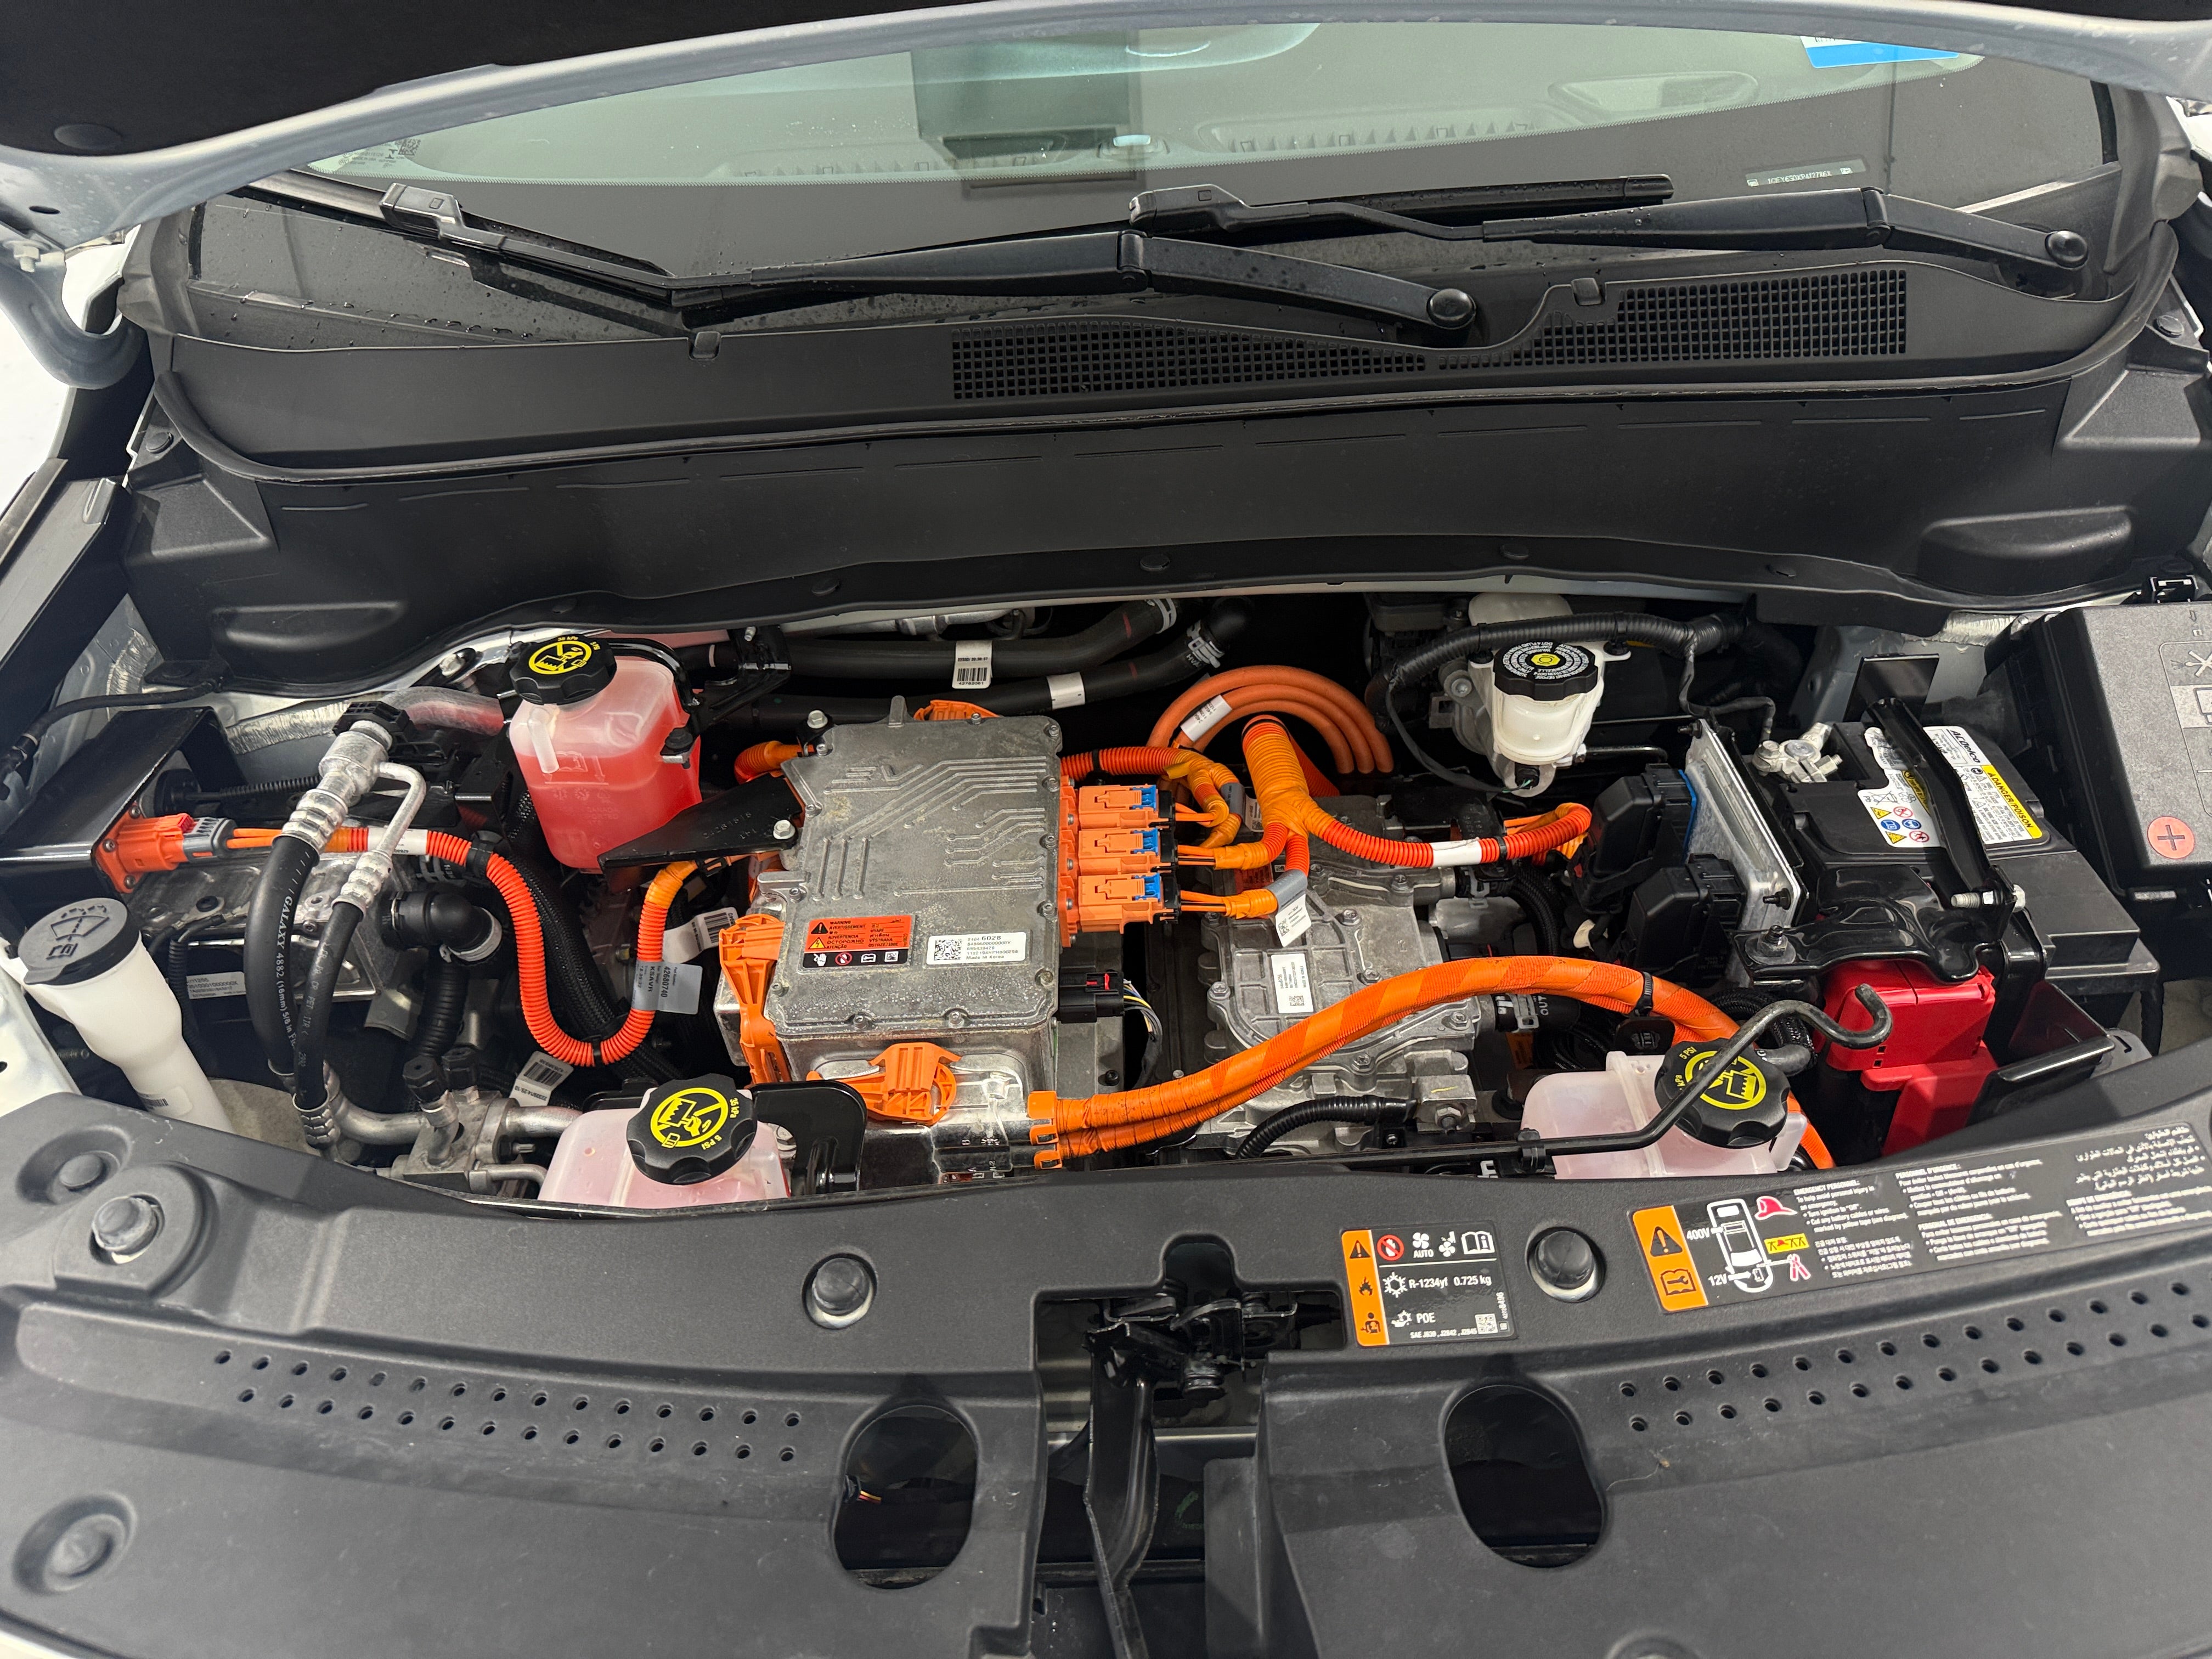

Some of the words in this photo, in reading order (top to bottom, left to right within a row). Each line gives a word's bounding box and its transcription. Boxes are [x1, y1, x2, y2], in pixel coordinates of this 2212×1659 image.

[1950, 730, 1980, 763] ACDelco
[276, 896, 292, 950] GALAXY
[276, 952, 285, 978] 4882
[661, 966, 671, 997] 42680740
[1538, 995, 1549, 1015] OUT
[1685, 1046, 1697, 1057] PSI
[730, 1098, 739, 1106] 35
[730, 1106, 740, 1118] kPa
[701, 1138, 716, 1150] PSI
[1793, 1184, 1826, 1195] EMERGENCY
[1827, 1180, 1860, 1190] PERSONNEL:
[1686, 1228, 1711, 1241] 400V
[1413, 1249, 1434, 1259] AUTO
[1408, 1277, 1448, 1289] R-1234yf
[1453, 1276, 1477, 1286] 0.725
[1479, 1274, 1492, 1286] kg
[1708, 1273, 1728, 1287] 12V
[1416, 1312, 1436, 1324] POE
[1410, 1331, 1422, 1339] SAE
